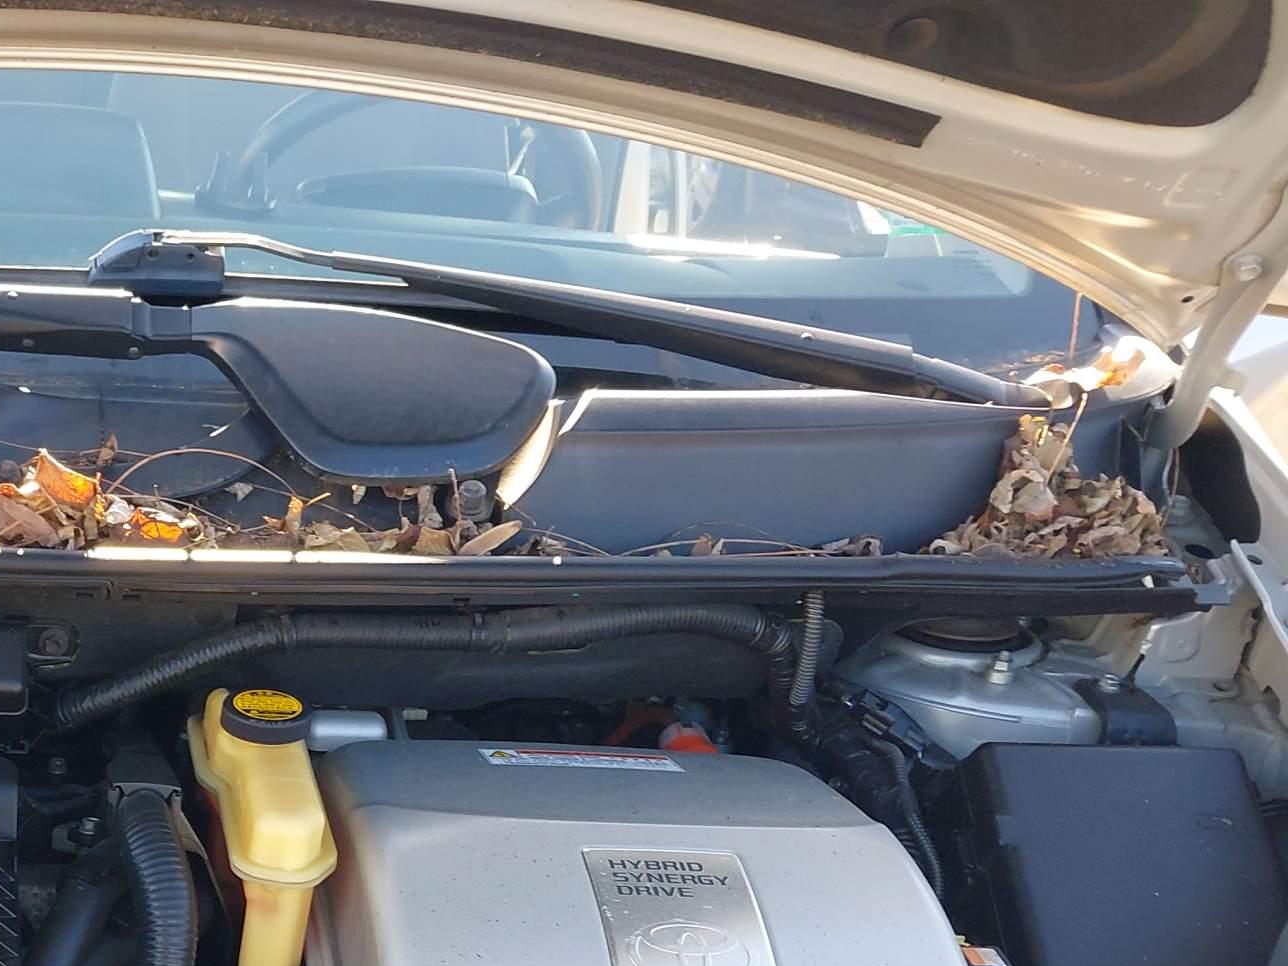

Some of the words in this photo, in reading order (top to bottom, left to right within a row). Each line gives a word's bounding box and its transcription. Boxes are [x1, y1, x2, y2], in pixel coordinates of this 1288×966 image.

[608, 858, 703, 872] HYBRID
[612, 872, 728, 887] SYNERGY
[617, 886, 694, 898] DRIVE
